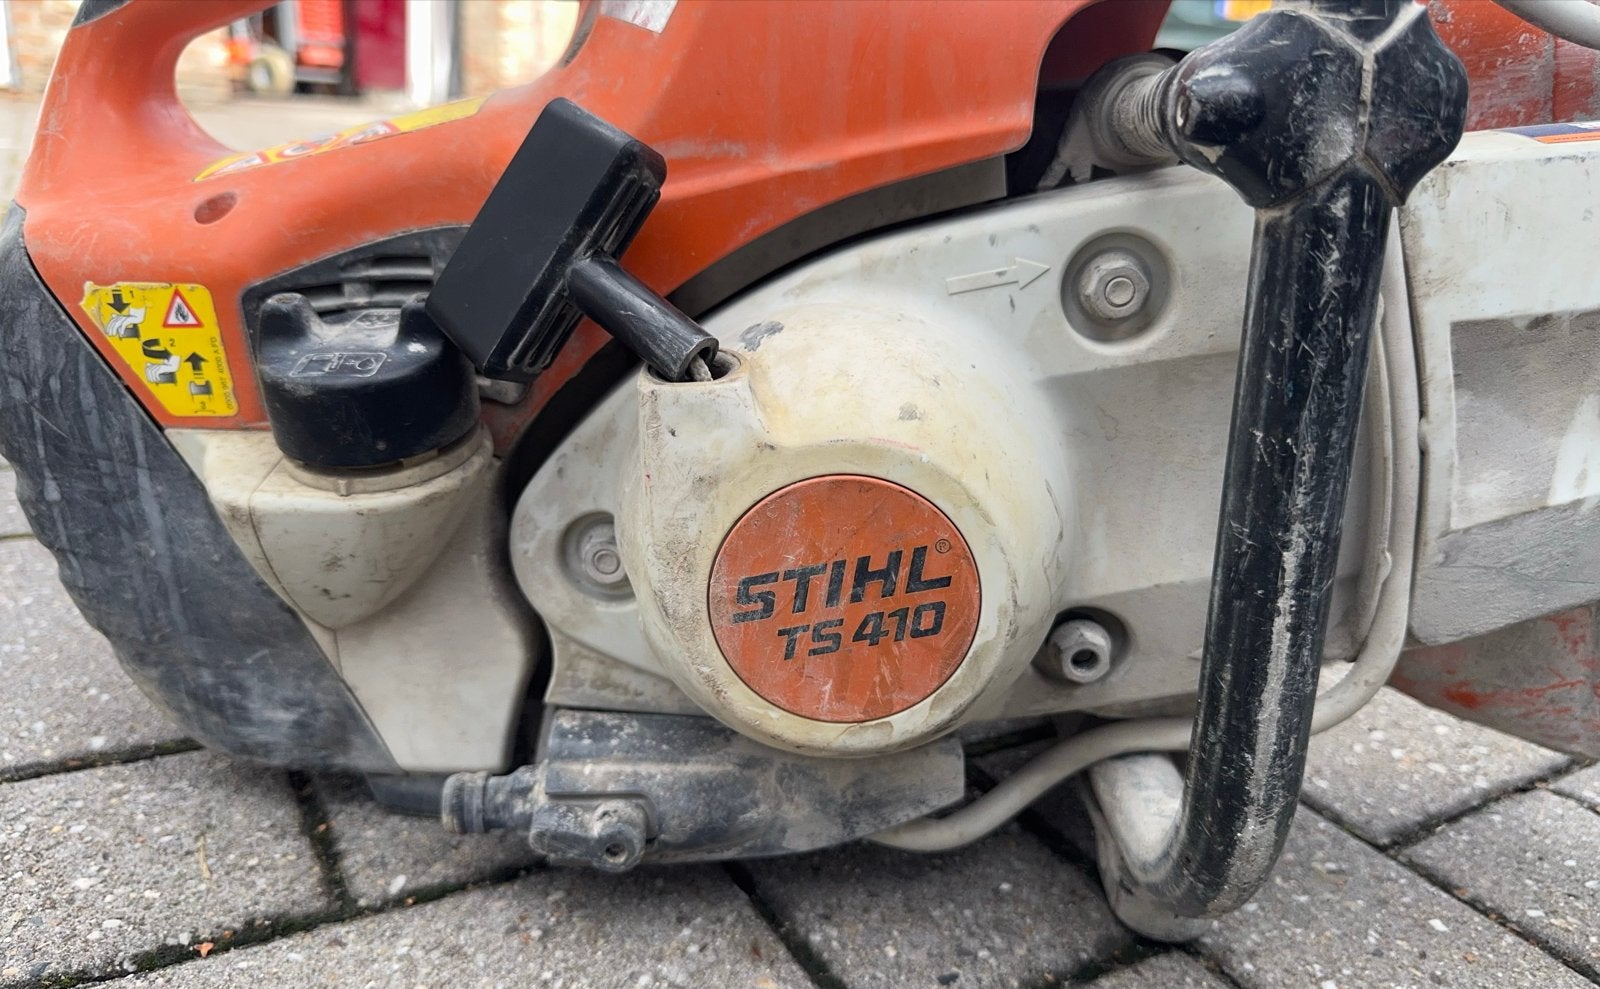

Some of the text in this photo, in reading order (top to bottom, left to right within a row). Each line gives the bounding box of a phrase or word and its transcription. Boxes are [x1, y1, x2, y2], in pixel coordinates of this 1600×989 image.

[169, 338, 176, 348] 2
[732, 546, 952, 624] STIHL
[777, 600, 947, 661] TS 410
